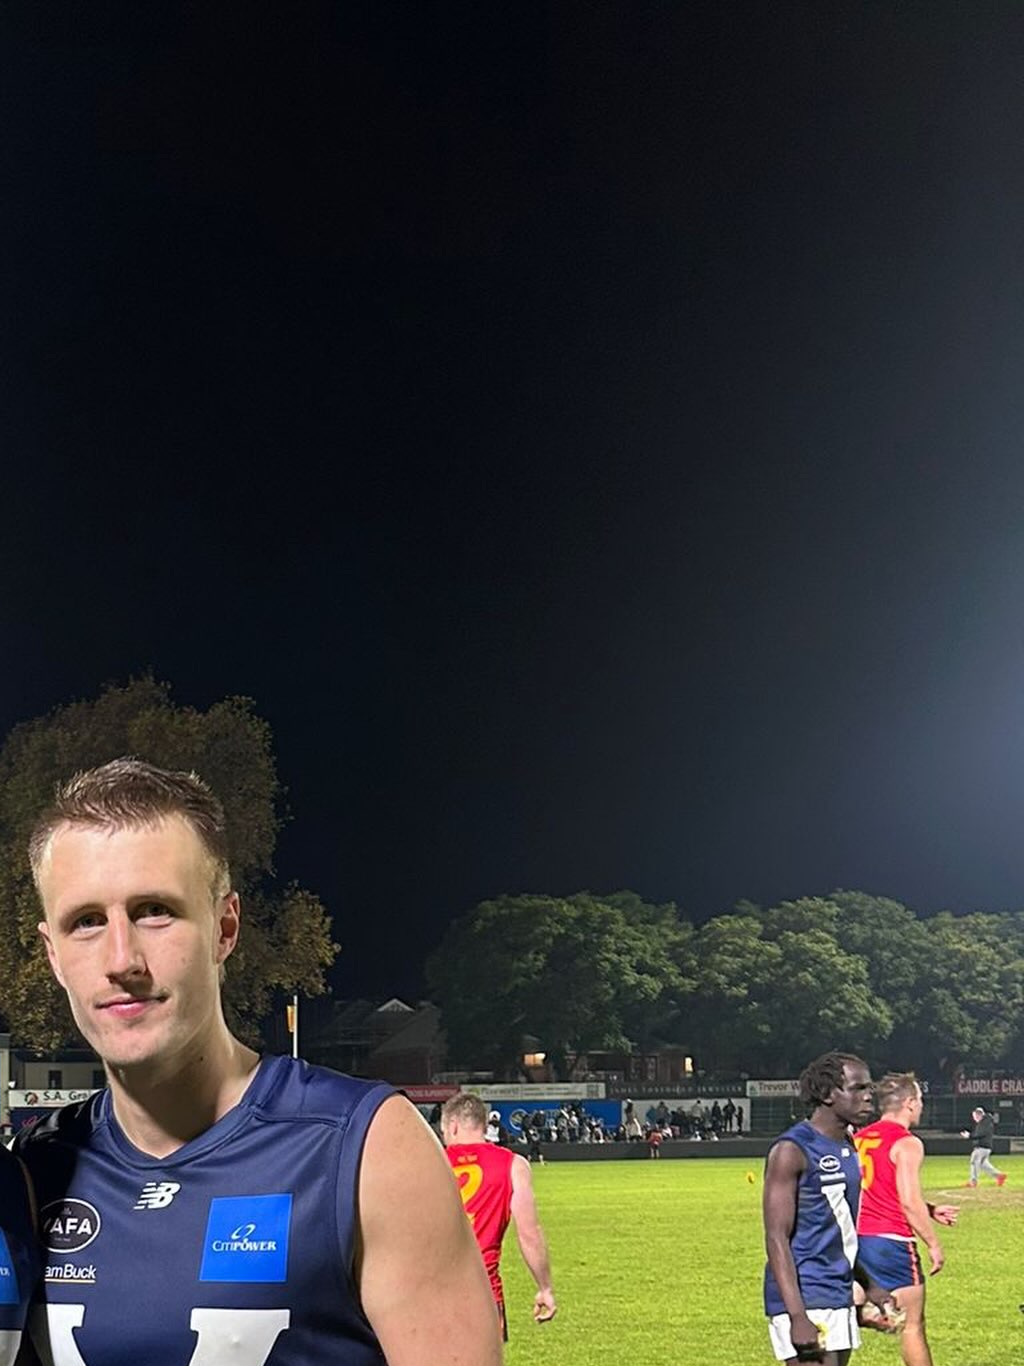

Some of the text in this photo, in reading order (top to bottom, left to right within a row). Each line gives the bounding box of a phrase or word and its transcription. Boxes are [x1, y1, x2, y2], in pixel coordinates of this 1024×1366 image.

[958, 1080, 998, 1092] CADDLE
[43, 1091, 89, 1100] S.A. Gra
[44, 1263, 96, 1279] amBuck
